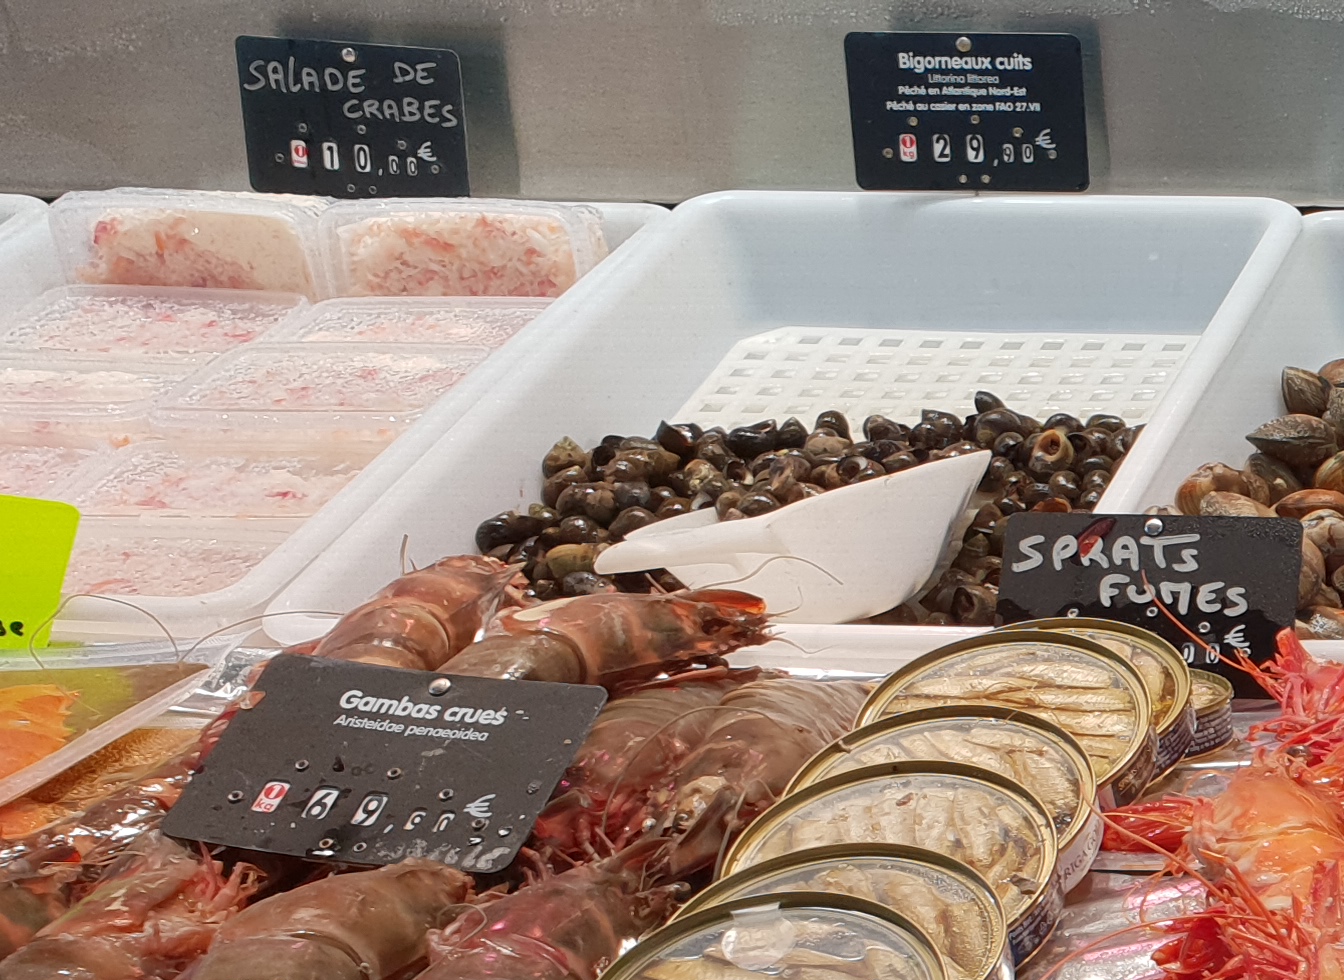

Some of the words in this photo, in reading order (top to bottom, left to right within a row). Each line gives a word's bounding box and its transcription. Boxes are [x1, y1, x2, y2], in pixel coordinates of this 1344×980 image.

[243, 56, 366, 93] SALADE
[393, 62, 437, 85] DE
[898, 53, 992, 73] Bigorneaux
[995, 55, 1032, 70] cuits
[930, 102, 956, 111] casier
[996, 102, 1013, 111] FAO
[942, 87, 987, 98] Atlantique
[989, 87, 1026, 96] Nord-Est
[343, 96, 458, 128] CRABES
[1011, 534, 1200, 572] SPRATS
[1100, 574, 1248, 616] FUMES
[340, 690, 438, 721] Gambas
[444, 703, 507, 726] crues
[334, 715, 404, 735] Aristeidae
[405, 724, 488, 742] penaeoidea
